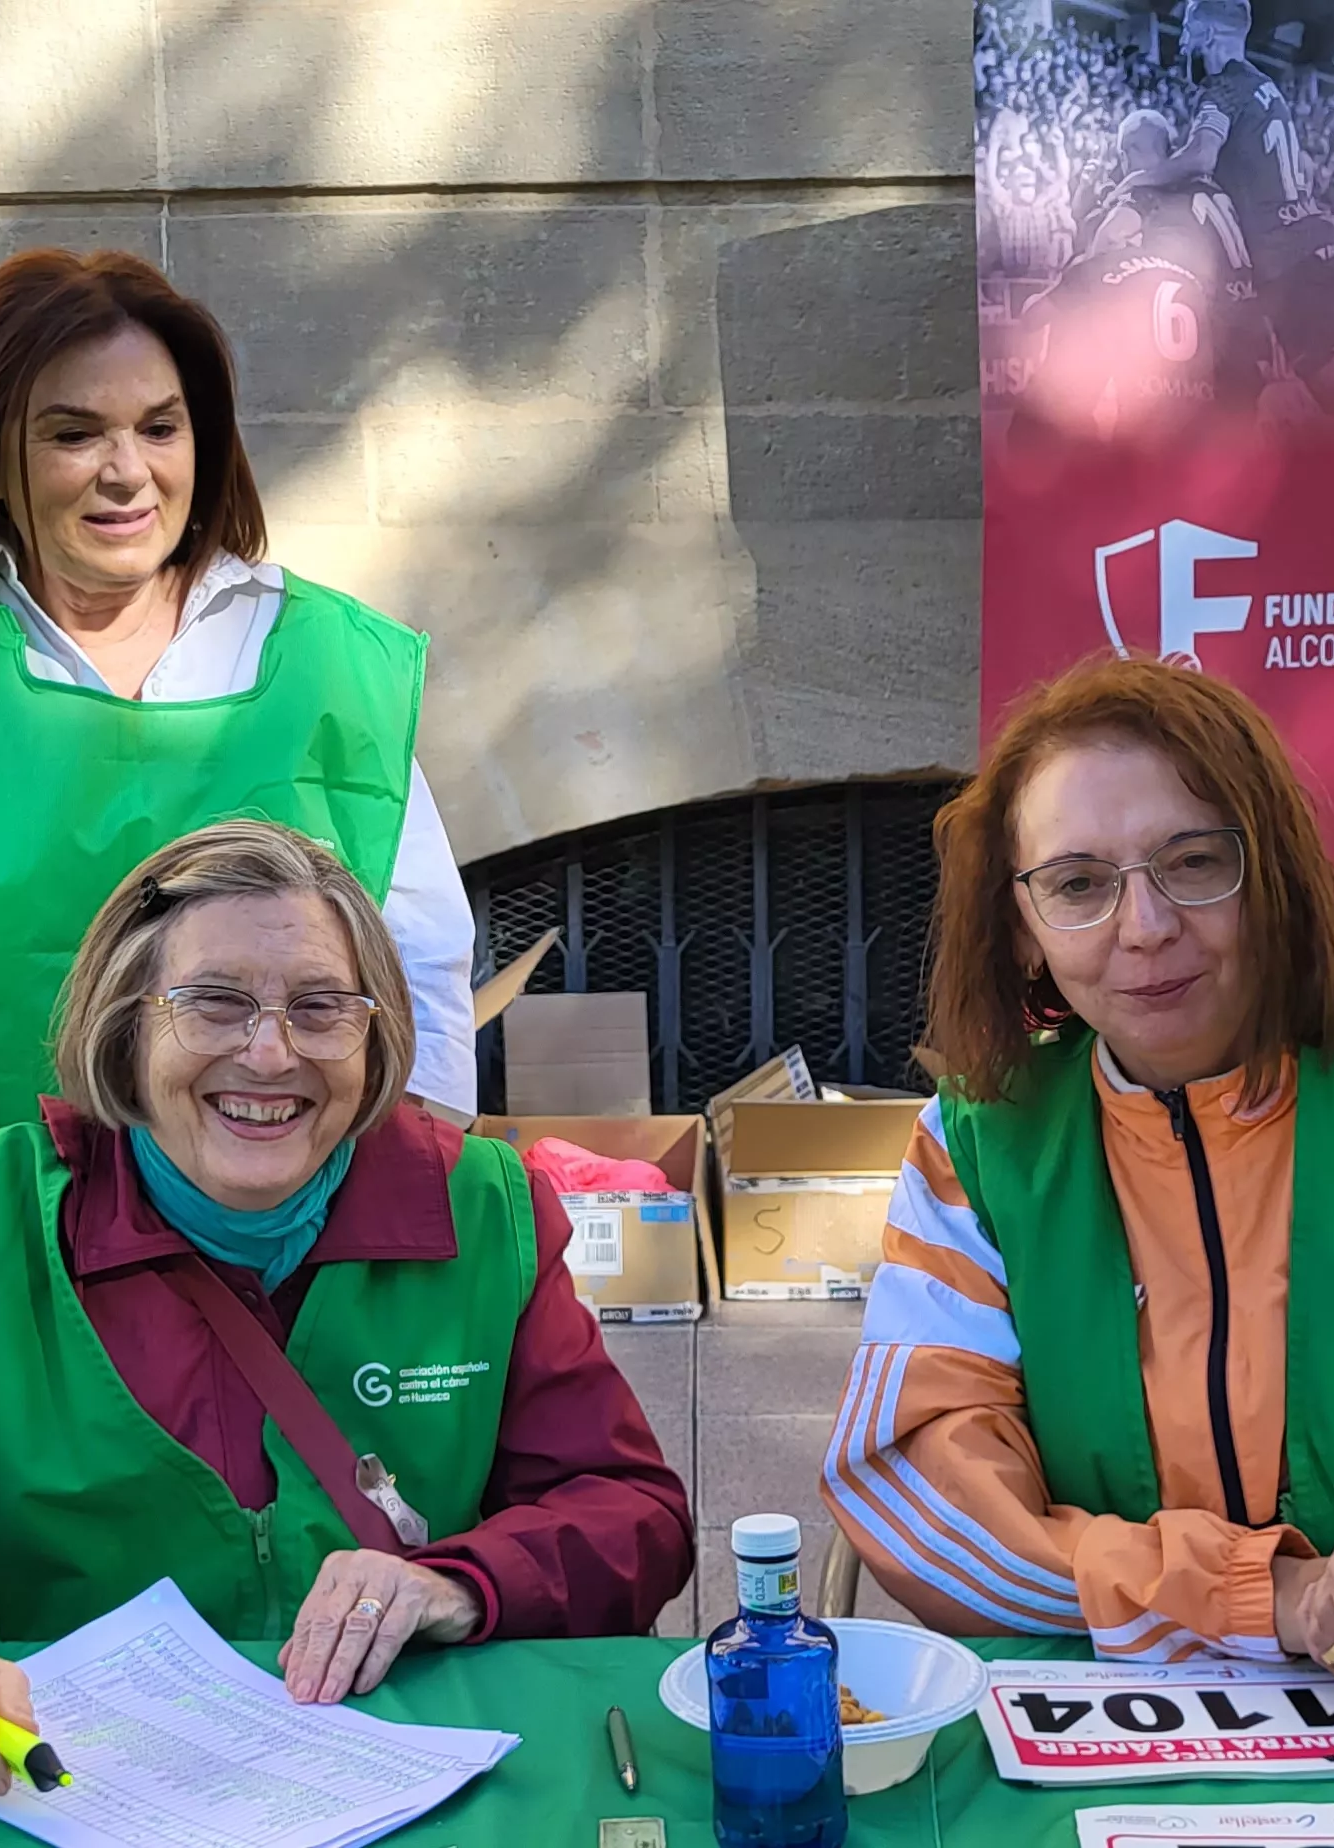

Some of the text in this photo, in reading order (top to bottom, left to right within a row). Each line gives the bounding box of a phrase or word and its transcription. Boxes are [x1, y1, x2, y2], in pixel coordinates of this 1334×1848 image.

[1153, 280, 1199, 361] 6
[753, 1205, 786, 1256] S
[1035, 1738, 1175, 1757] CÁNCER
[1182, 1738, 1225, 1752] EL
[1161, 1749, 1265, 1761] HUESCA
